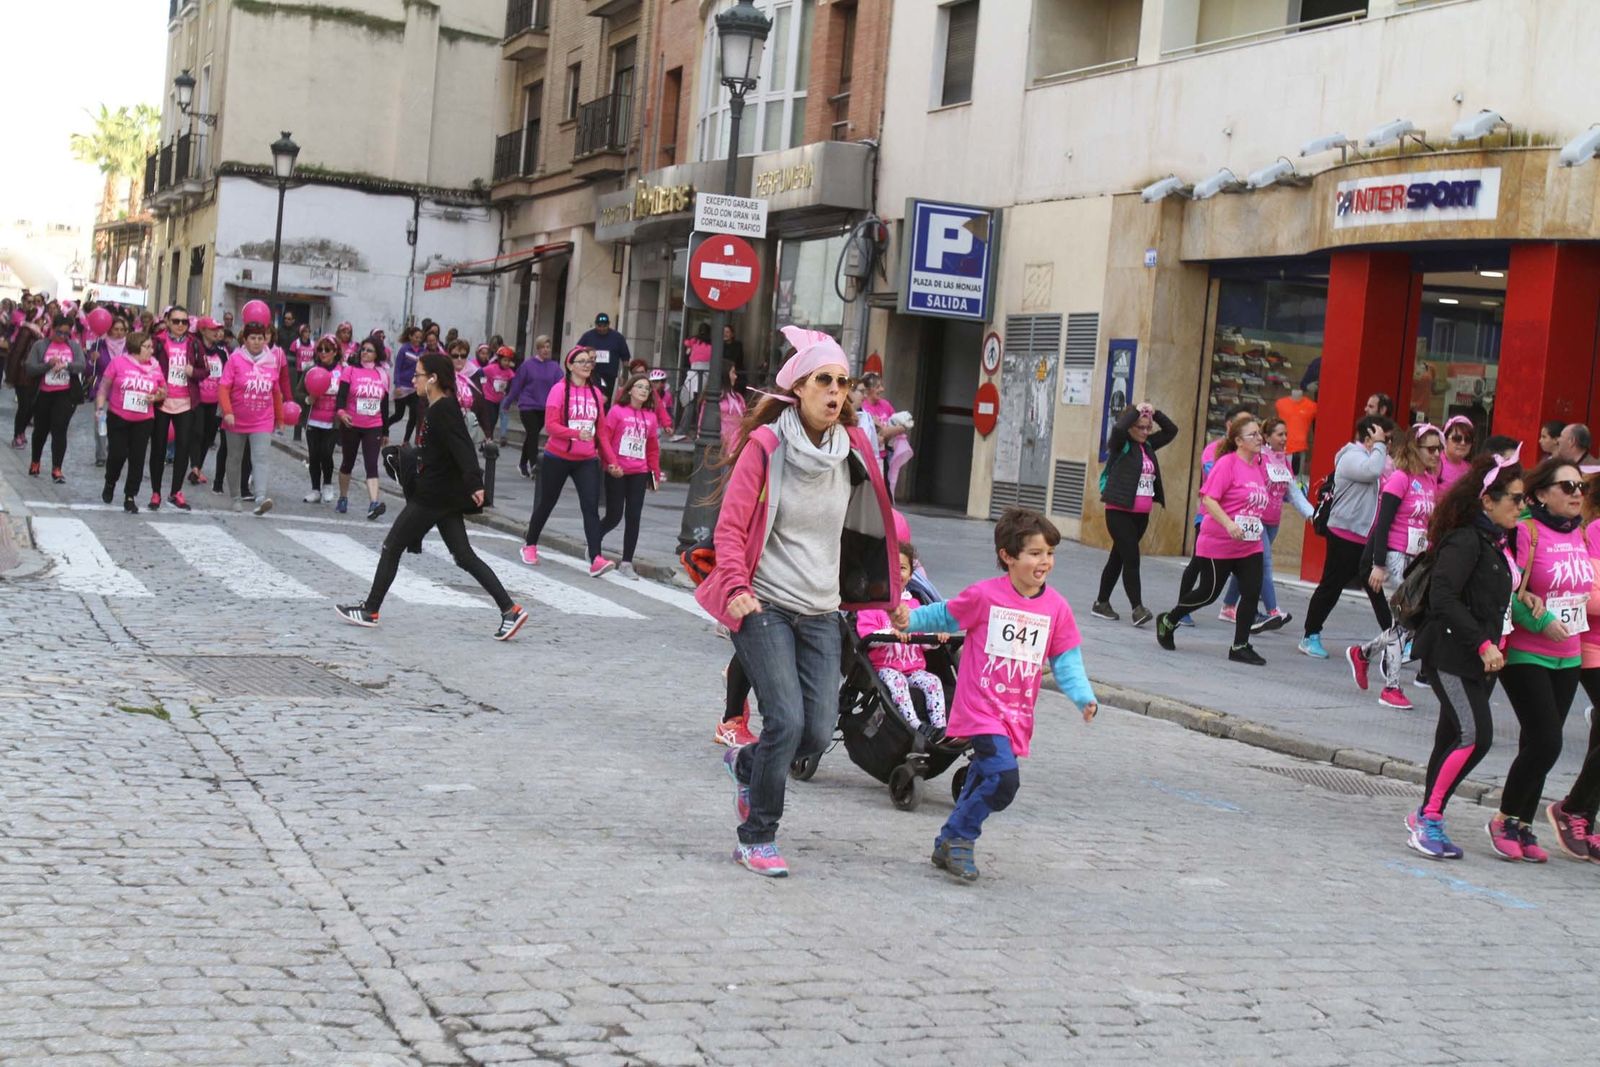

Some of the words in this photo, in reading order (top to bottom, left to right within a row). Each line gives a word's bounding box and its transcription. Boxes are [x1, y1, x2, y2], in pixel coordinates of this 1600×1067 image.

[756, 162, 814, 197] PERFUMERIA
[706, 196, 732, 207] EXCEPTO
[732, 199, 759, 210] GARAJES
[1349, 179, 1483, 214] INTERSPORT
[703, 206, 719, 216] SOLO
[720, 209, 732, 218] CON
[733, 210, 749, 220] GRAN
[751, 213, 761, 221] VIA
[700, 217, 728, 228] CORTADA
[728, 221, 736, 229] AL
[737, 222, 761, 233] TRAFICO
[925, 213, 973, 269] P
[913, 277, 933, 287] PLAZA
[933, 280, 942, 288] DE
[943, 281, 954, 290] LAS
[955, 283, 982, 293] MONJAS
[926, 294, 968, 311] SALIDA
[627, 442, 643, 452] 164
[1242, 523, 1260, 533] 342
[1561, 608, 1583, 623] 571
[1002, 623, 1039, 647] 641
